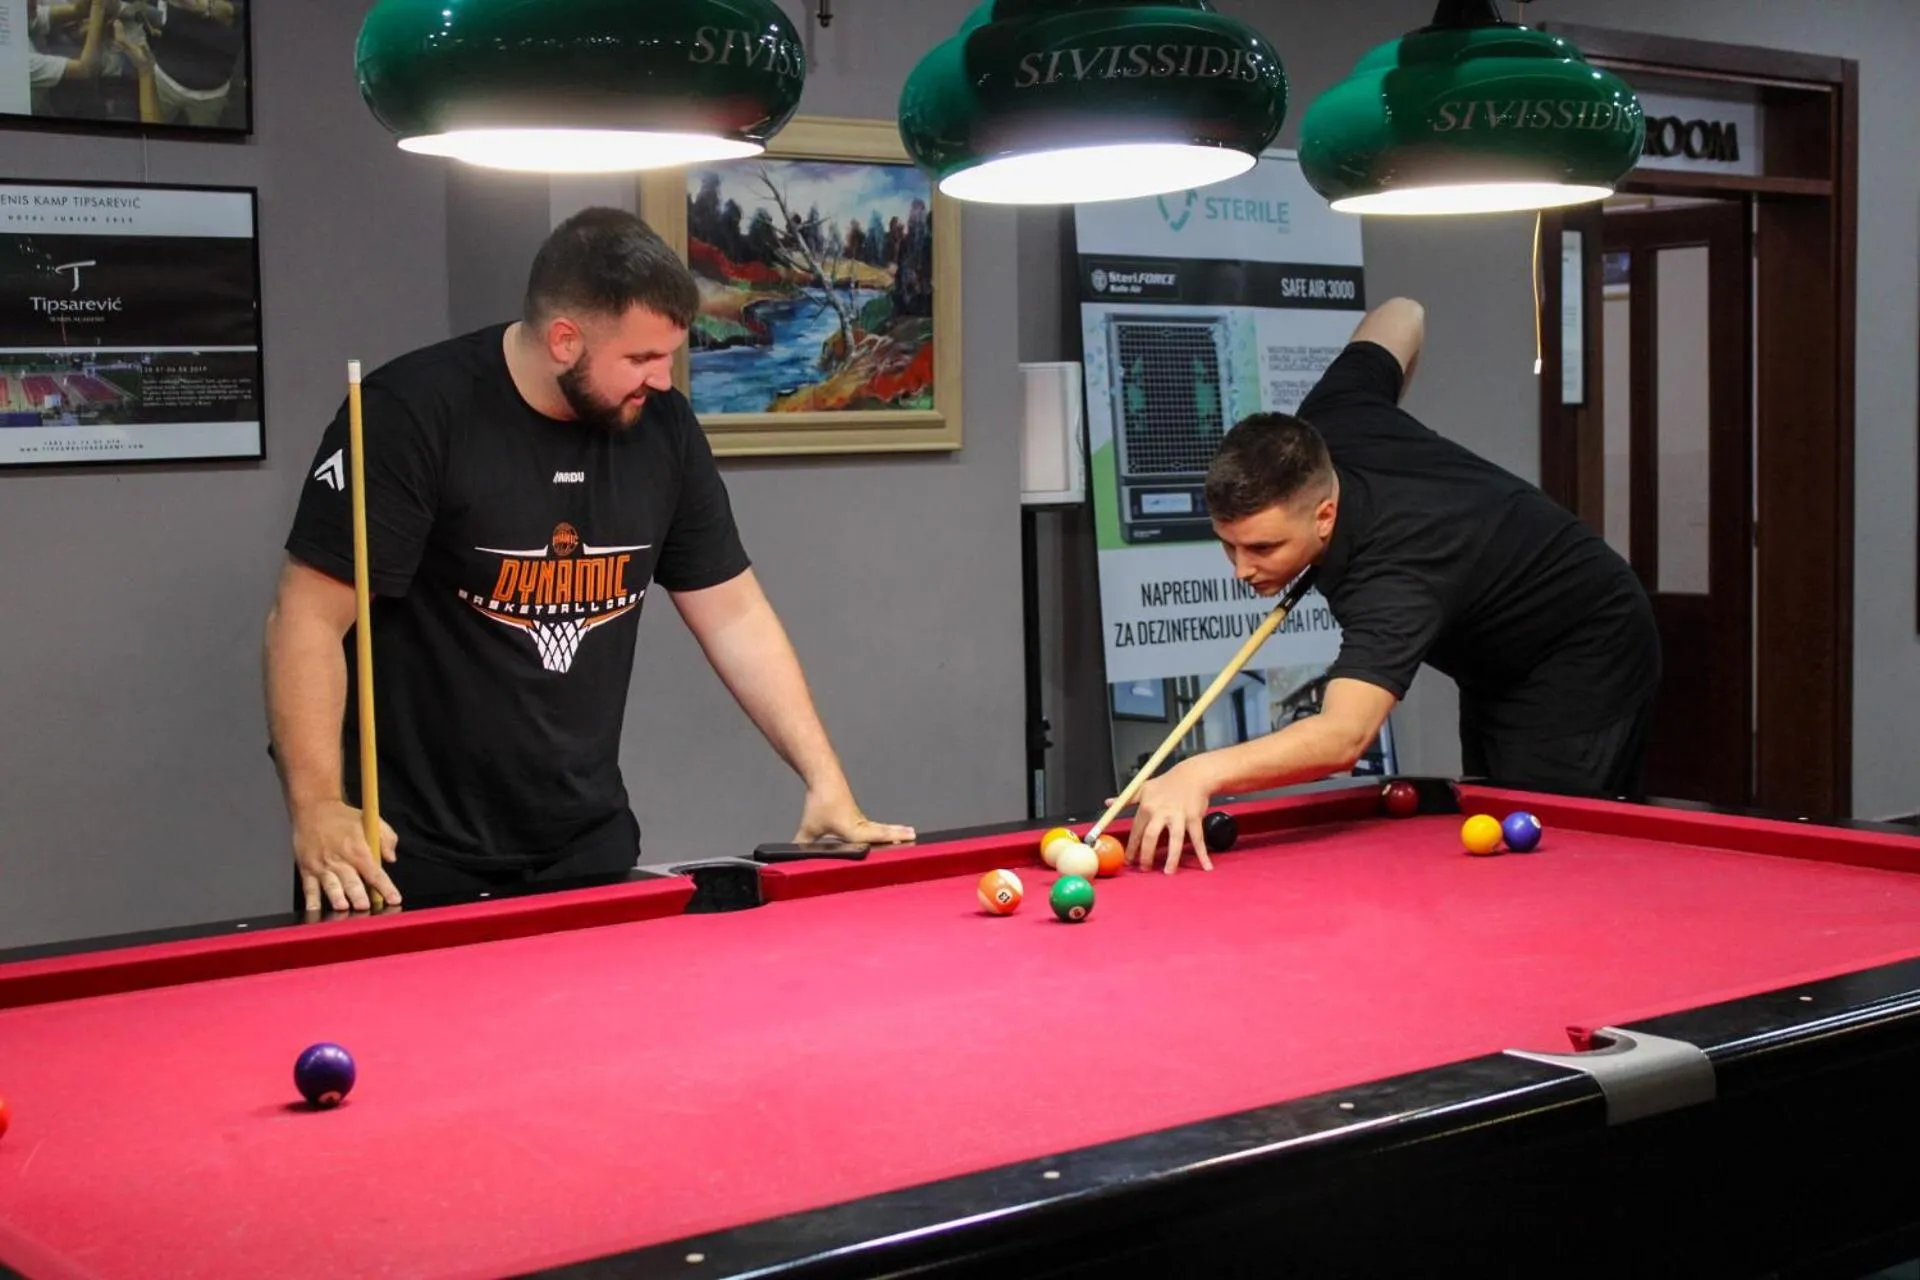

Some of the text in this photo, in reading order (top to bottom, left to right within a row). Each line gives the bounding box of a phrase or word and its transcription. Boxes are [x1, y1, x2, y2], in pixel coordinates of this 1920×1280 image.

[1014, 44, 1259, 88] SIVISSIDIS
[1433, 99, 1636, 134] SIVISSIDIS
[33, 195, 68, 206] KAMP
[1205, 196, 1289, 224] STERILE
[1281, 278, 1355, 300] SAFE AIR 3000
[29, 296, 122, 315] Tipsarević
[491, 554, 631, 605] DYNAMIC
[1141, 578, 1219, 608] NAPREDNI
[1114, 622, 1135, 648] ZA
[1137, 613, 1243, 646] DEZINFEKCIJU
